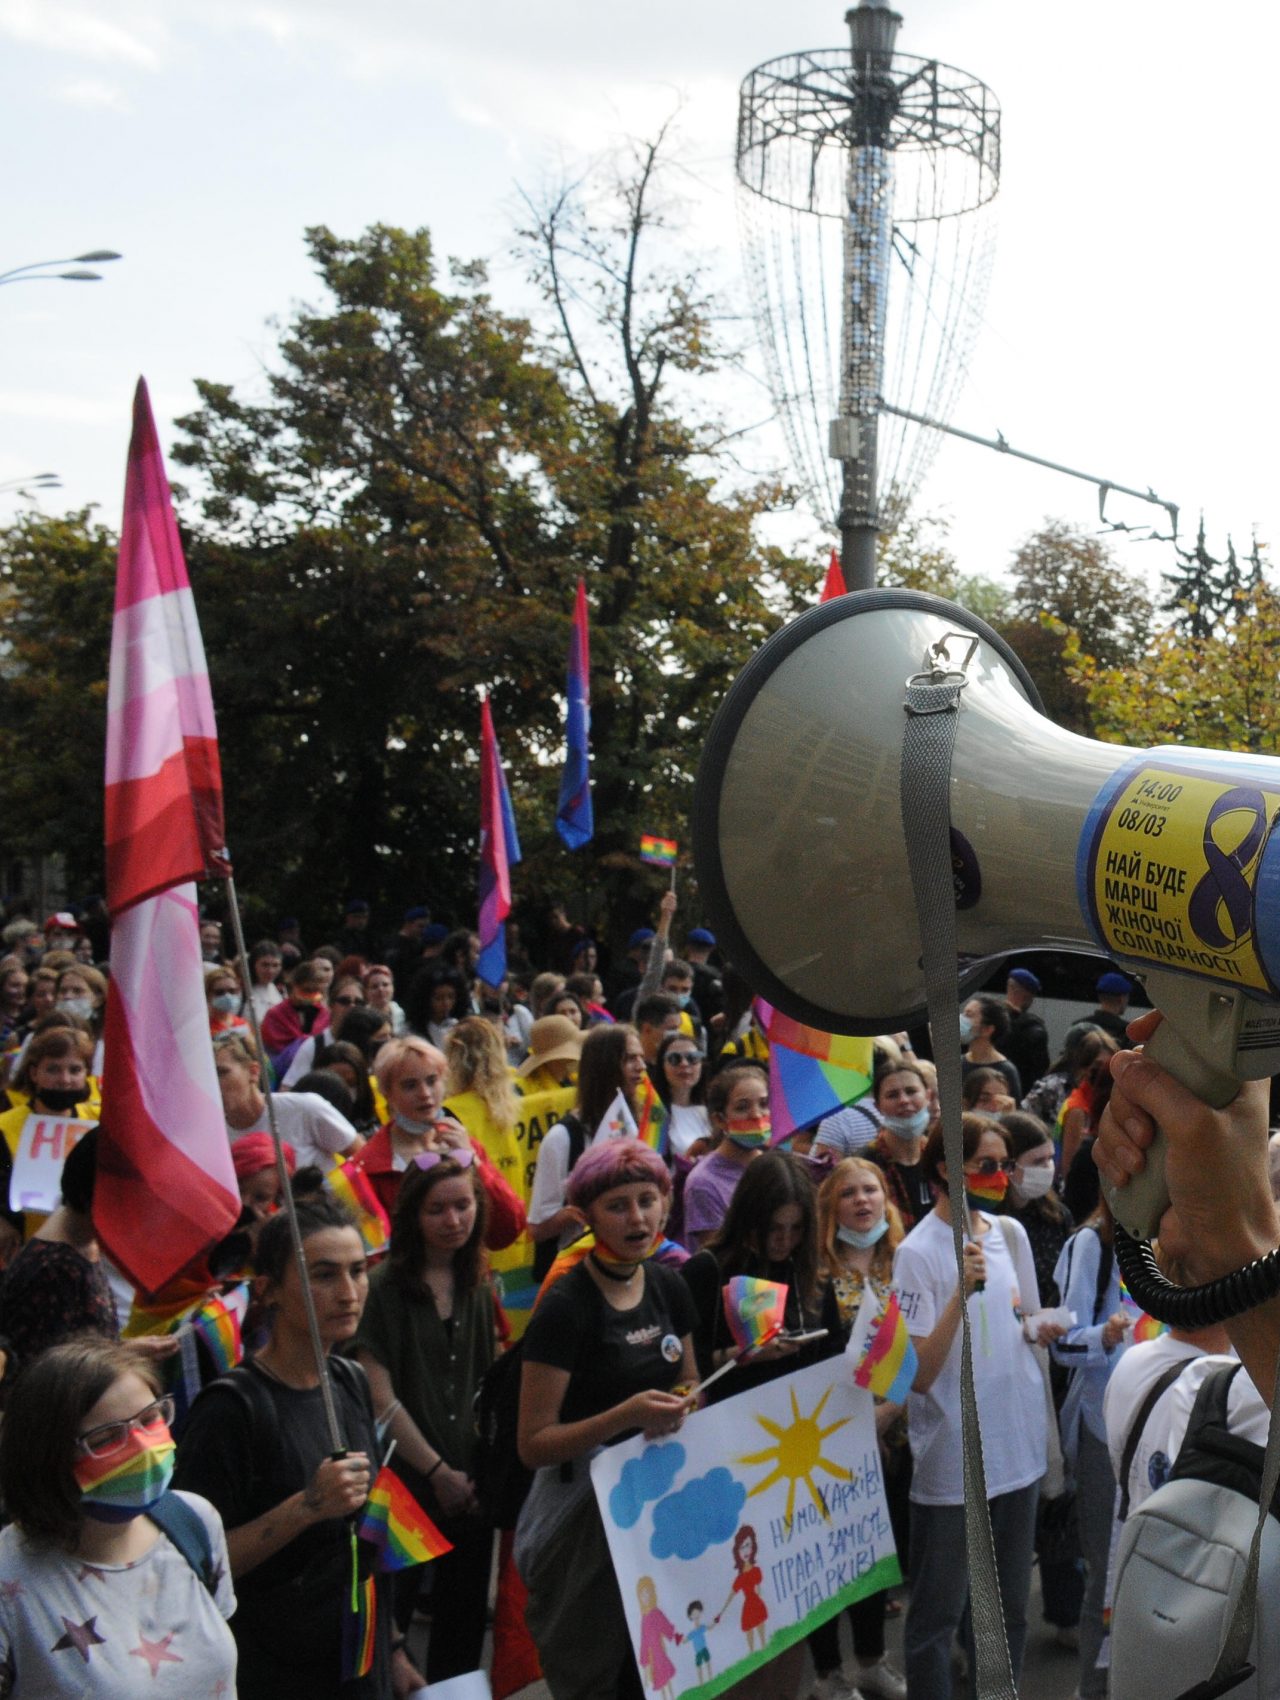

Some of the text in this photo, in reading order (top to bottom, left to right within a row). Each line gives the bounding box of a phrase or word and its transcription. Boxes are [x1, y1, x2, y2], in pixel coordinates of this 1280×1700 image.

[1136, 779, 1183, 803] 14:00
[1118, 807, 1167, 838] 08/03
[1105, 850, 1188, 898] НАЙ БУДЕ
[1105, 878, 1158, 913] МАРШ
[1106, 903, 1185, 943] ЖІНОЧОЇ
[1113, 928, 1242, 977] СОЛІДАРНОСТІ
[771, 1541, 824, 1604] ПРАВА
